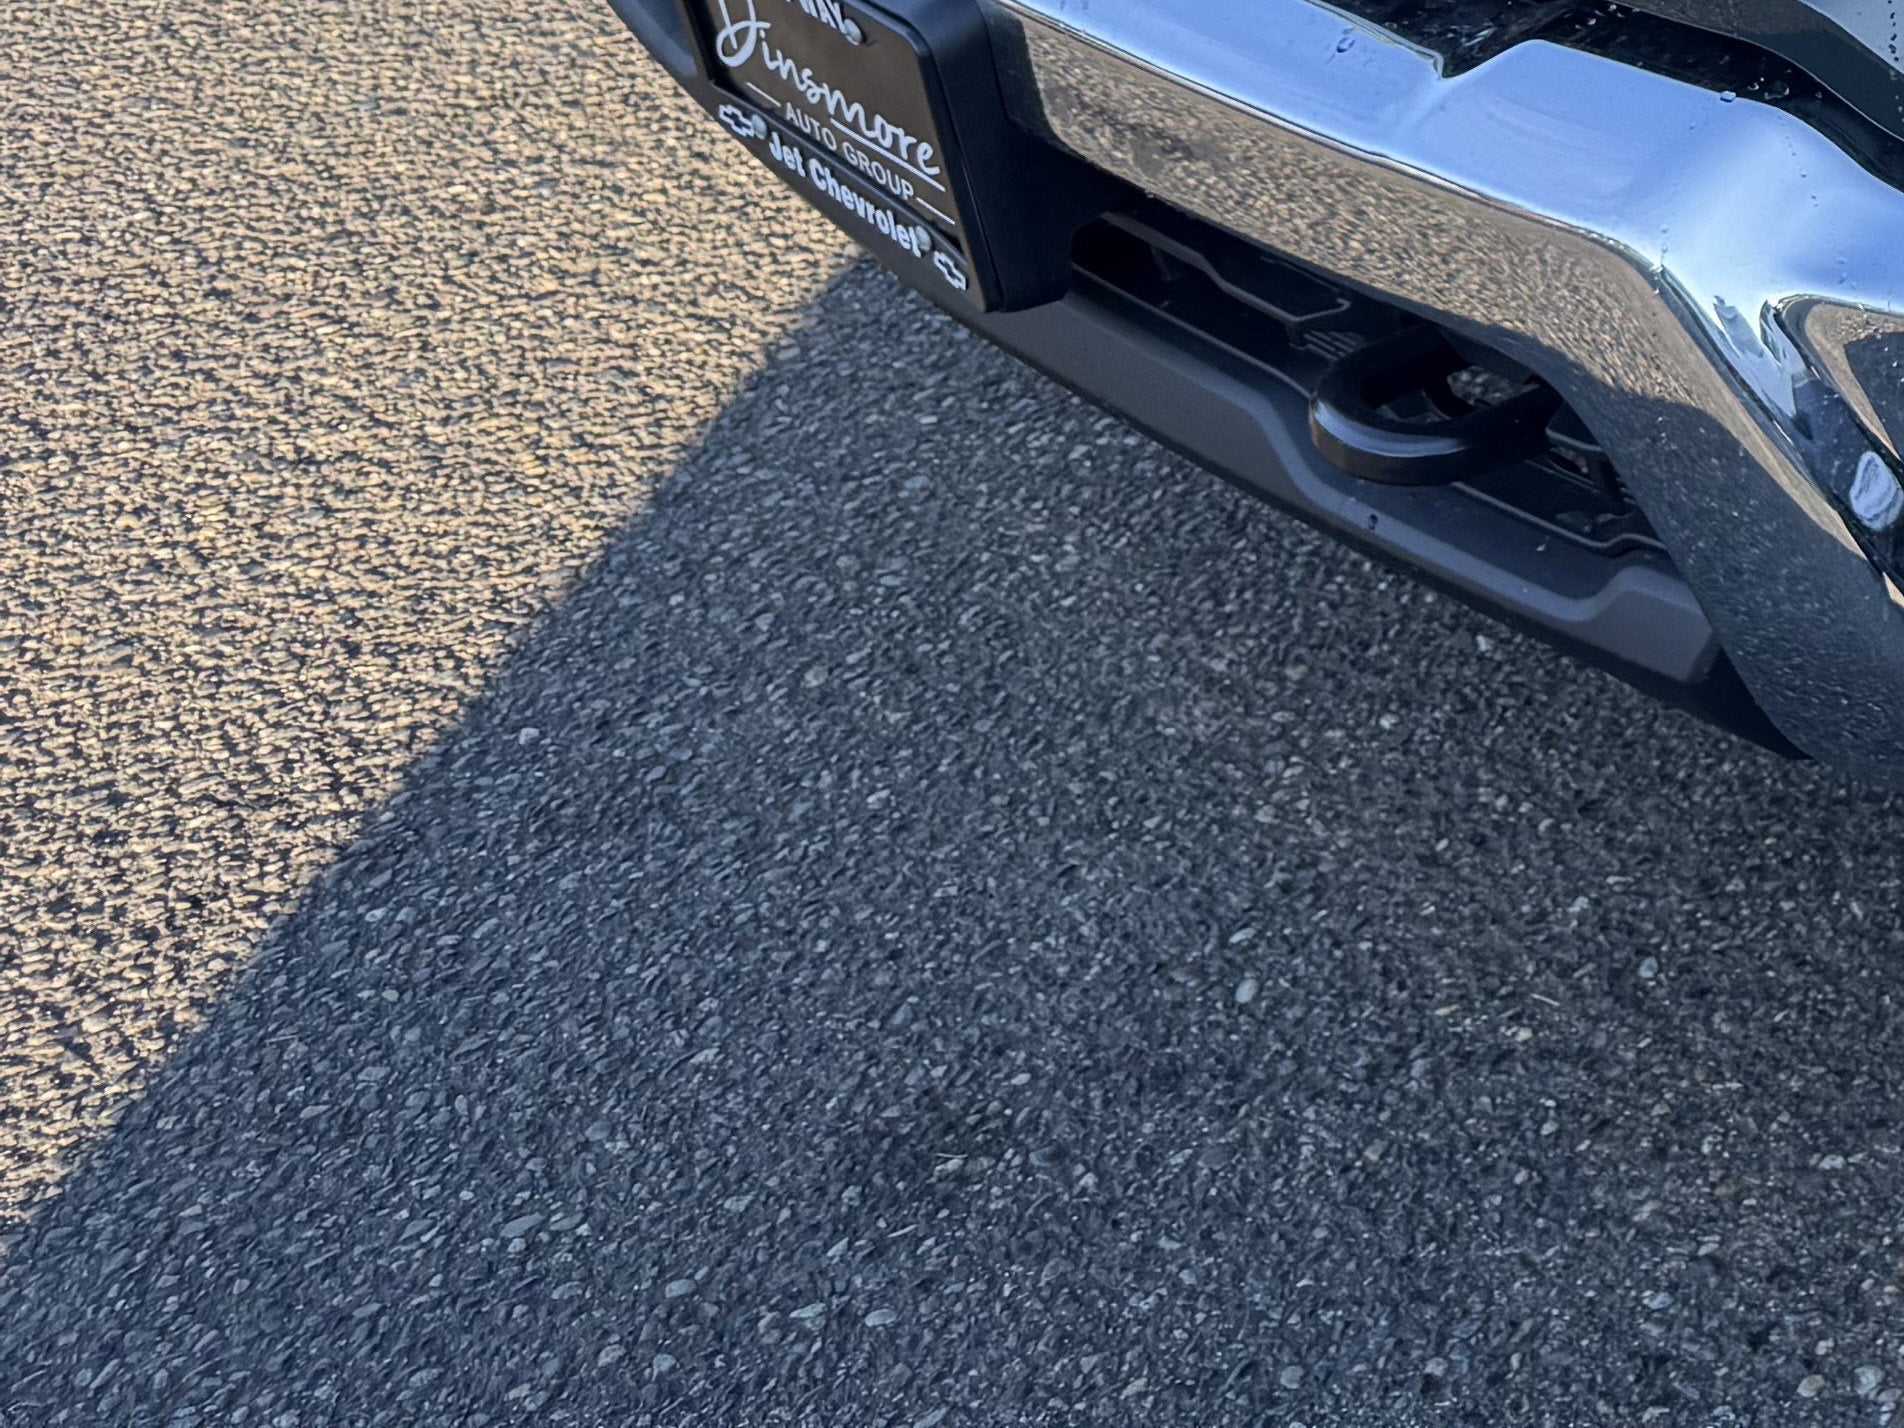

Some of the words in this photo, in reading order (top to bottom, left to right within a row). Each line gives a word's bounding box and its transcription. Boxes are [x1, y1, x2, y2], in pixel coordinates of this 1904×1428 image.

[769, 131, 806, 178] Jet
[808, 158, 922, 259] Chevrolet
[784, 102, 838, 151] AUTO
[842, 141, 914, 200] GROUP
